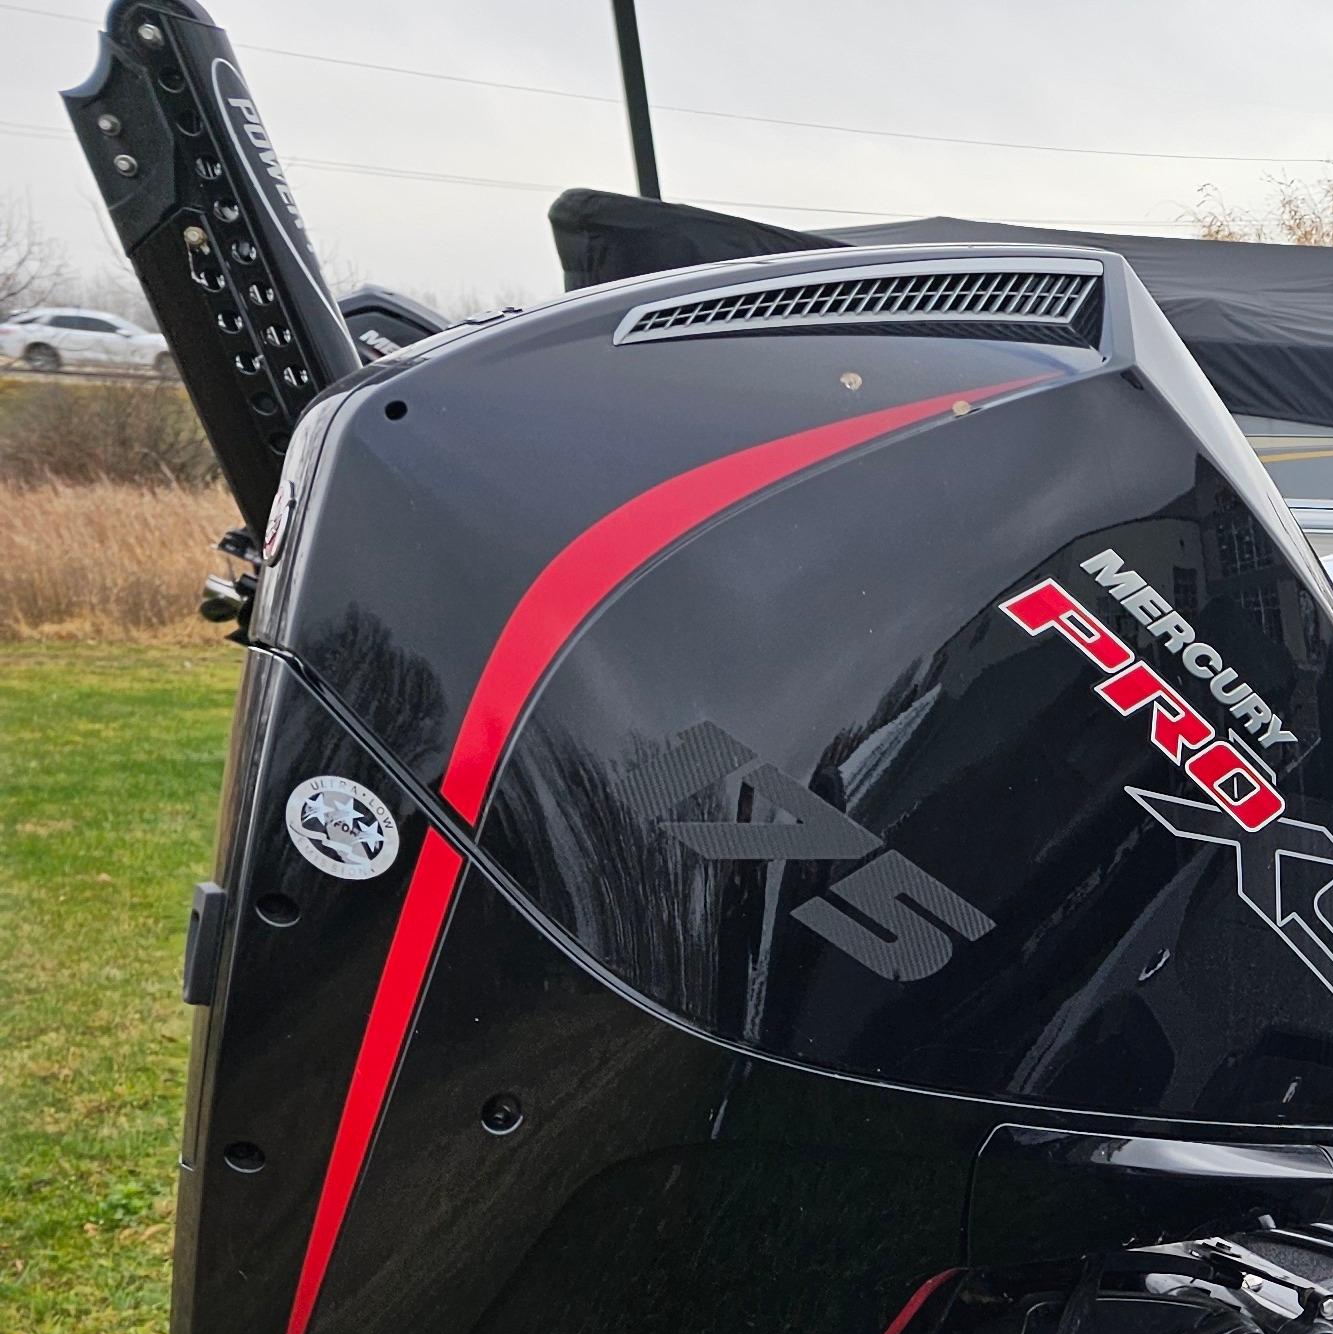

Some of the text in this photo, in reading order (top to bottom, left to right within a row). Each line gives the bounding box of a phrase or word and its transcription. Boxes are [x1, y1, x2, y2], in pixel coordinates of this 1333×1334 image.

[998, 577, 1285, 832] PRO
[1080, 549, 1298, 748] MERCURY
[368, 799, 394, 829] LOW
